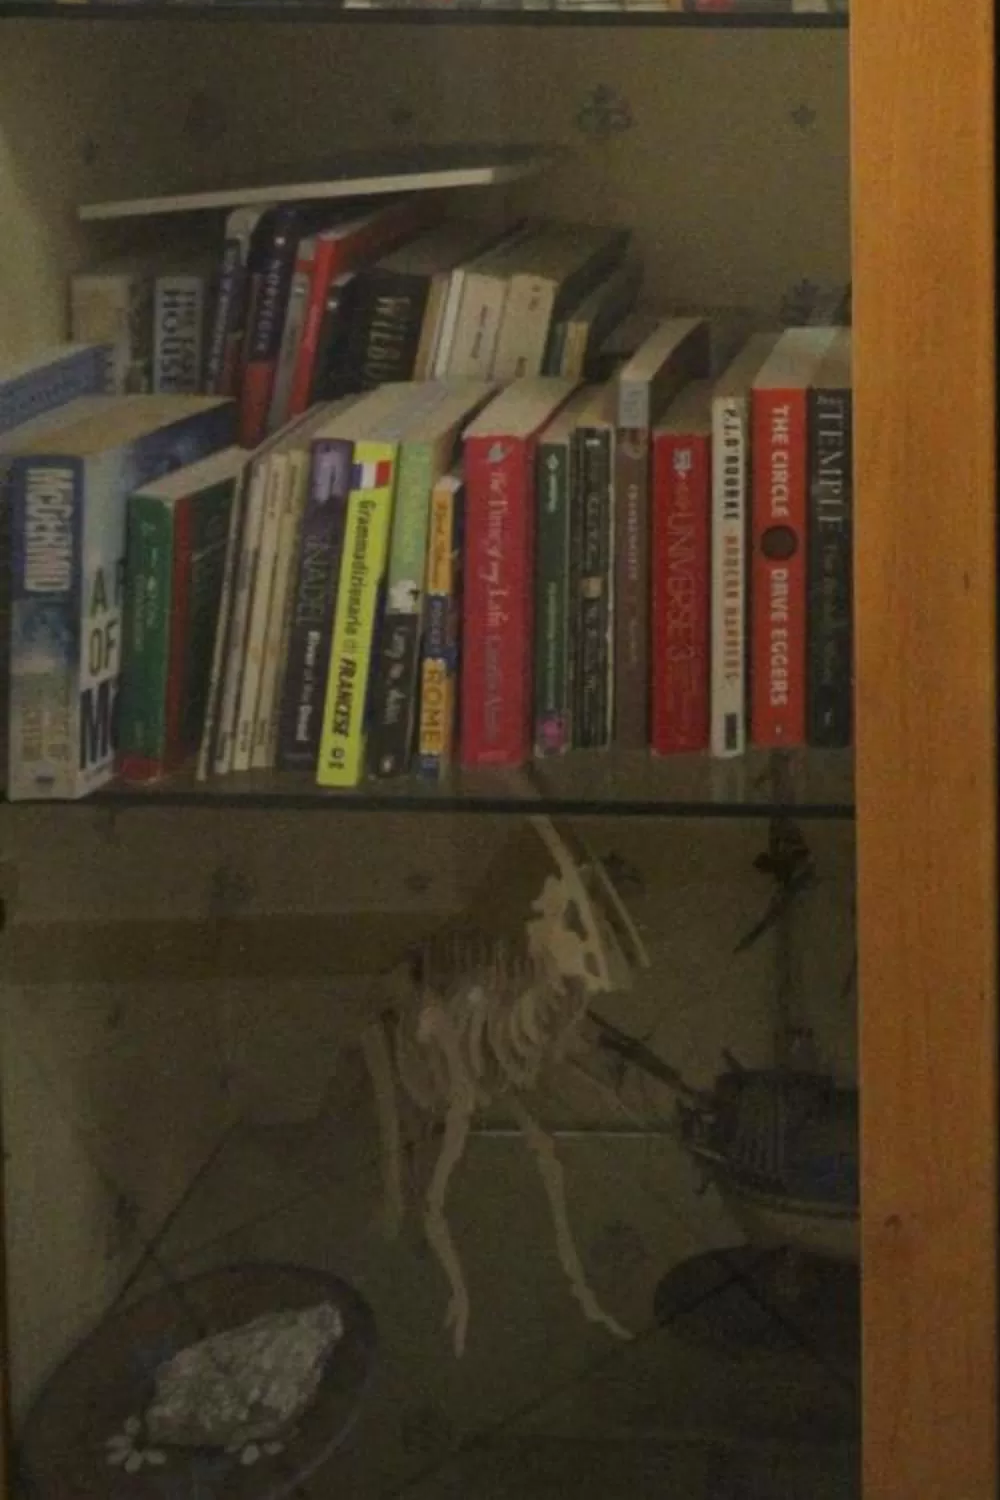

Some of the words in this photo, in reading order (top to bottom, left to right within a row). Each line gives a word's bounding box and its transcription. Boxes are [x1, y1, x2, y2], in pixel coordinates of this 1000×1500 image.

[771, 403, 790, 445] THE
[770, 449, 790, 519] CIRCLE
[816, 407, 845, 533] TEMPLE
[769, 567, 790, 622] DAVE
[332, 656, 357, 739] FRANCESE
[424, 666, 446, 745] ROME
[769, 627, 790, 706] EGGERS
